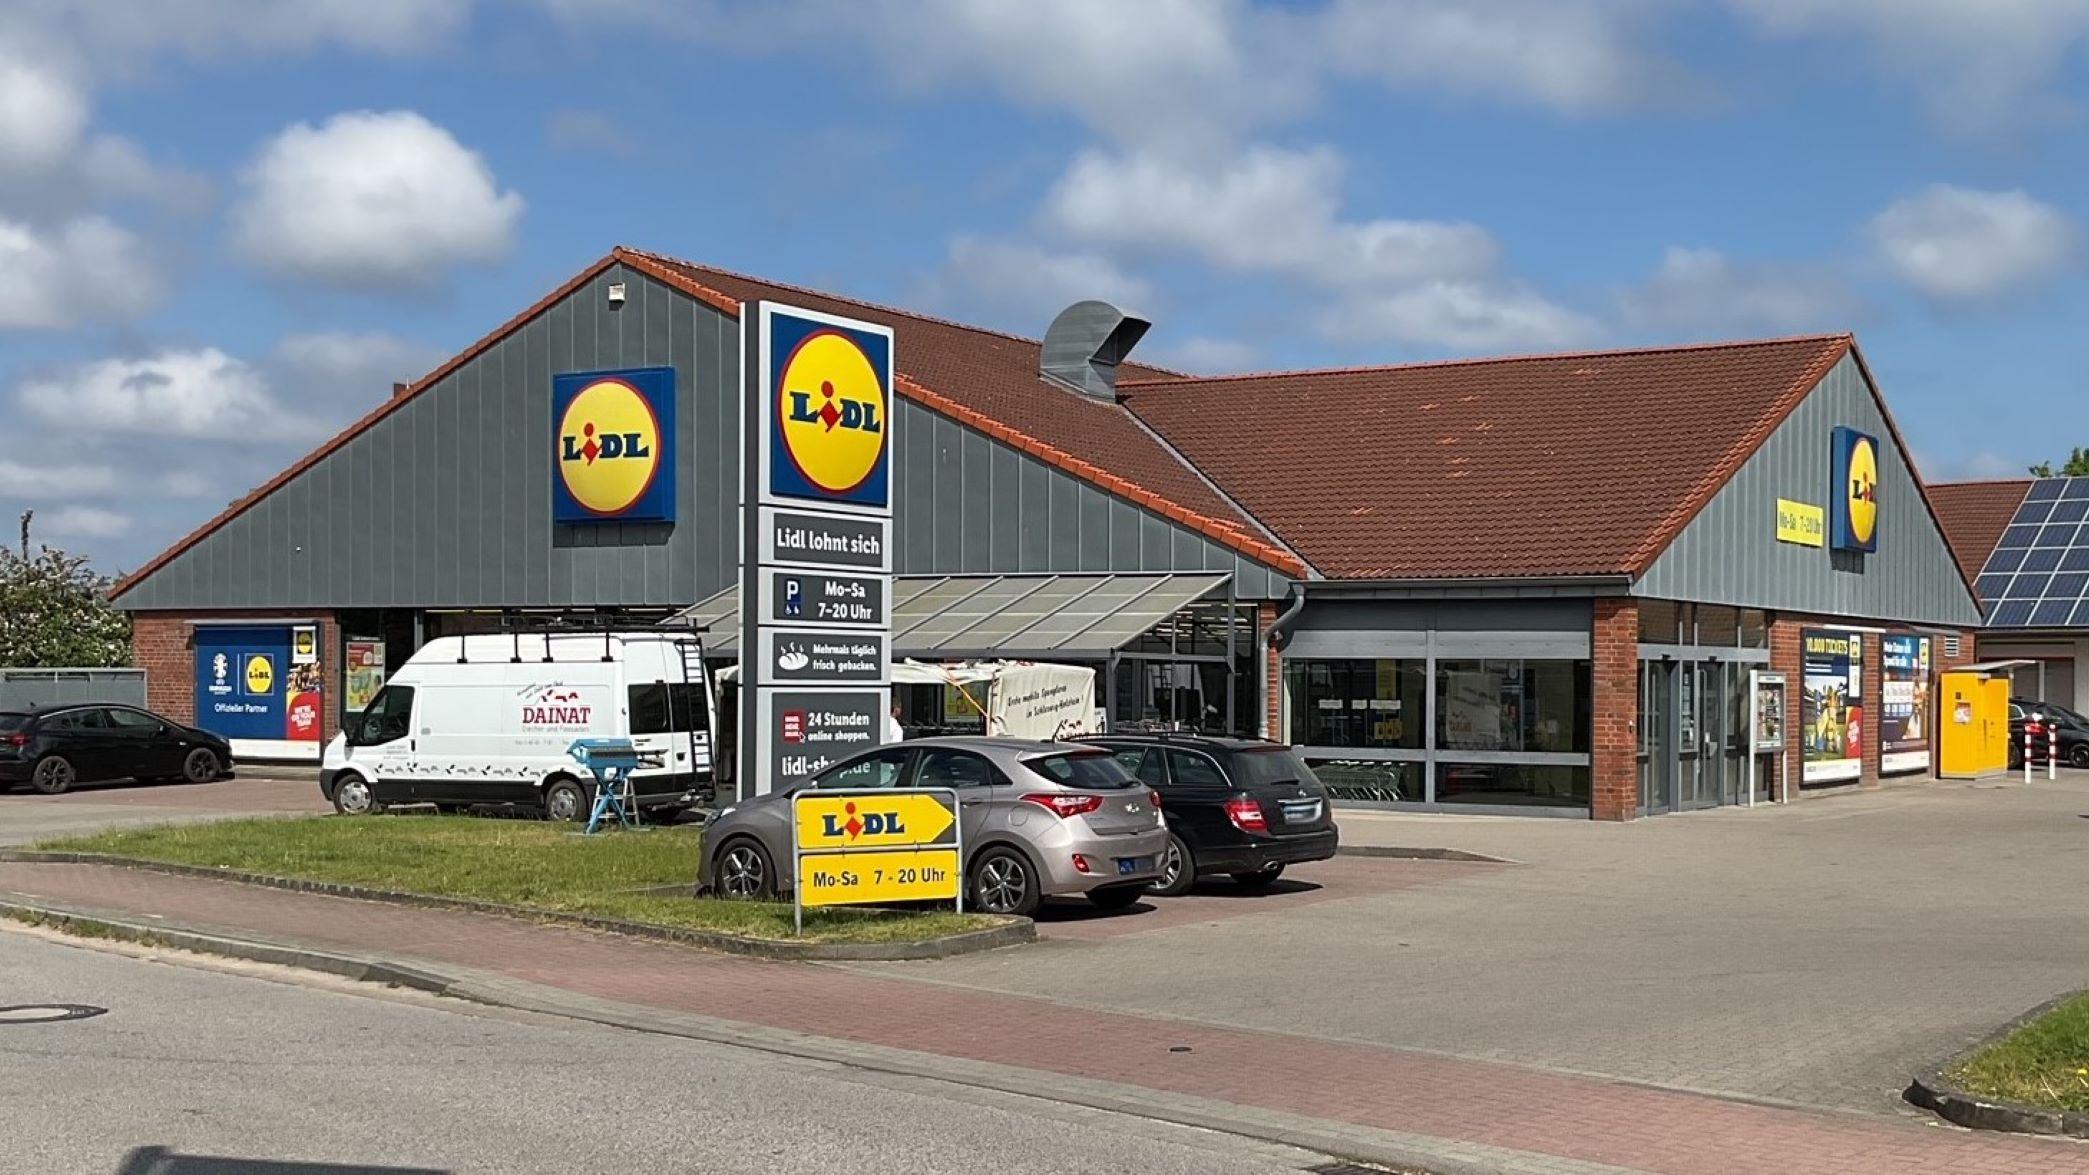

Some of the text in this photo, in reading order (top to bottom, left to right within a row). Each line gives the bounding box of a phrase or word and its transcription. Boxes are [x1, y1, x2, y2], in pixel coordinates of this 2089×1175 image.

[776, 527, 880, 554] Lidl lohnt sich
[786, 580, 799, 600] P
[824, 580, 866, 598] Mo-Sa
[817, 602, 872, 619] 7-20 Uhr
[813, 643, 877, 657] Mehrmals täglich
[813, 659, 836, 670] frisch
[245, 703, 269, 713] Partner
[522, 707, 591, 724] DAINAT
[808, 711, 870, 727] 24 Stunden
[808, 730, 832, 741] online
[813, 870, 858, 888] Mo-Sa
[897, 868, 917, 884] 20
[921, 867, 946, 882] Uhr
